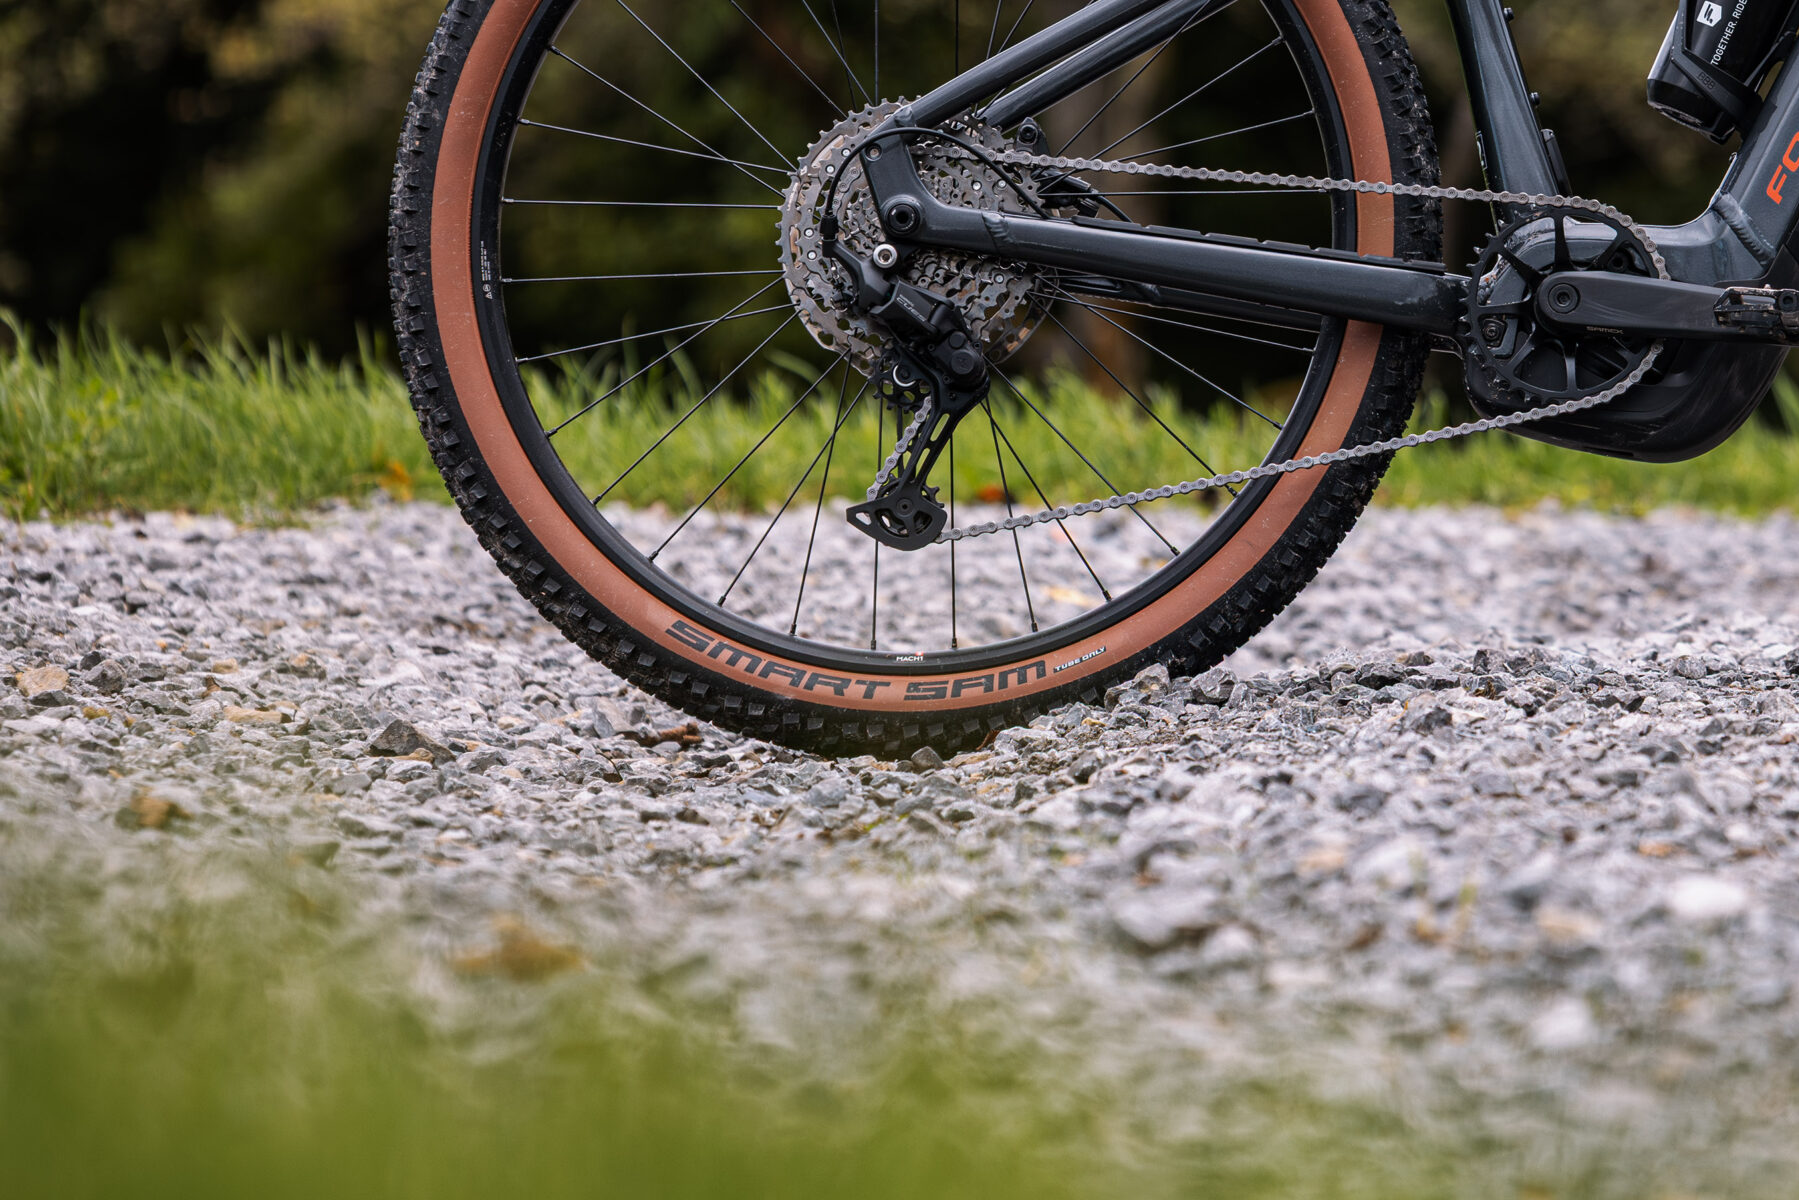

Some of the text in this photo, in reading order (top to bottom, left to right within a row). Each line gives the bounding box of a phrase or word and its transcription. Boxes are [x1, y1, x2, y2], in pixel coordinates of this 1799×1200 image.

[1710, 20, 1738, 66] TOGETHER.
[665, 620, 1047, 701] SMART SAM
[1053, 646, 1106, 673] TUBE ONLY
